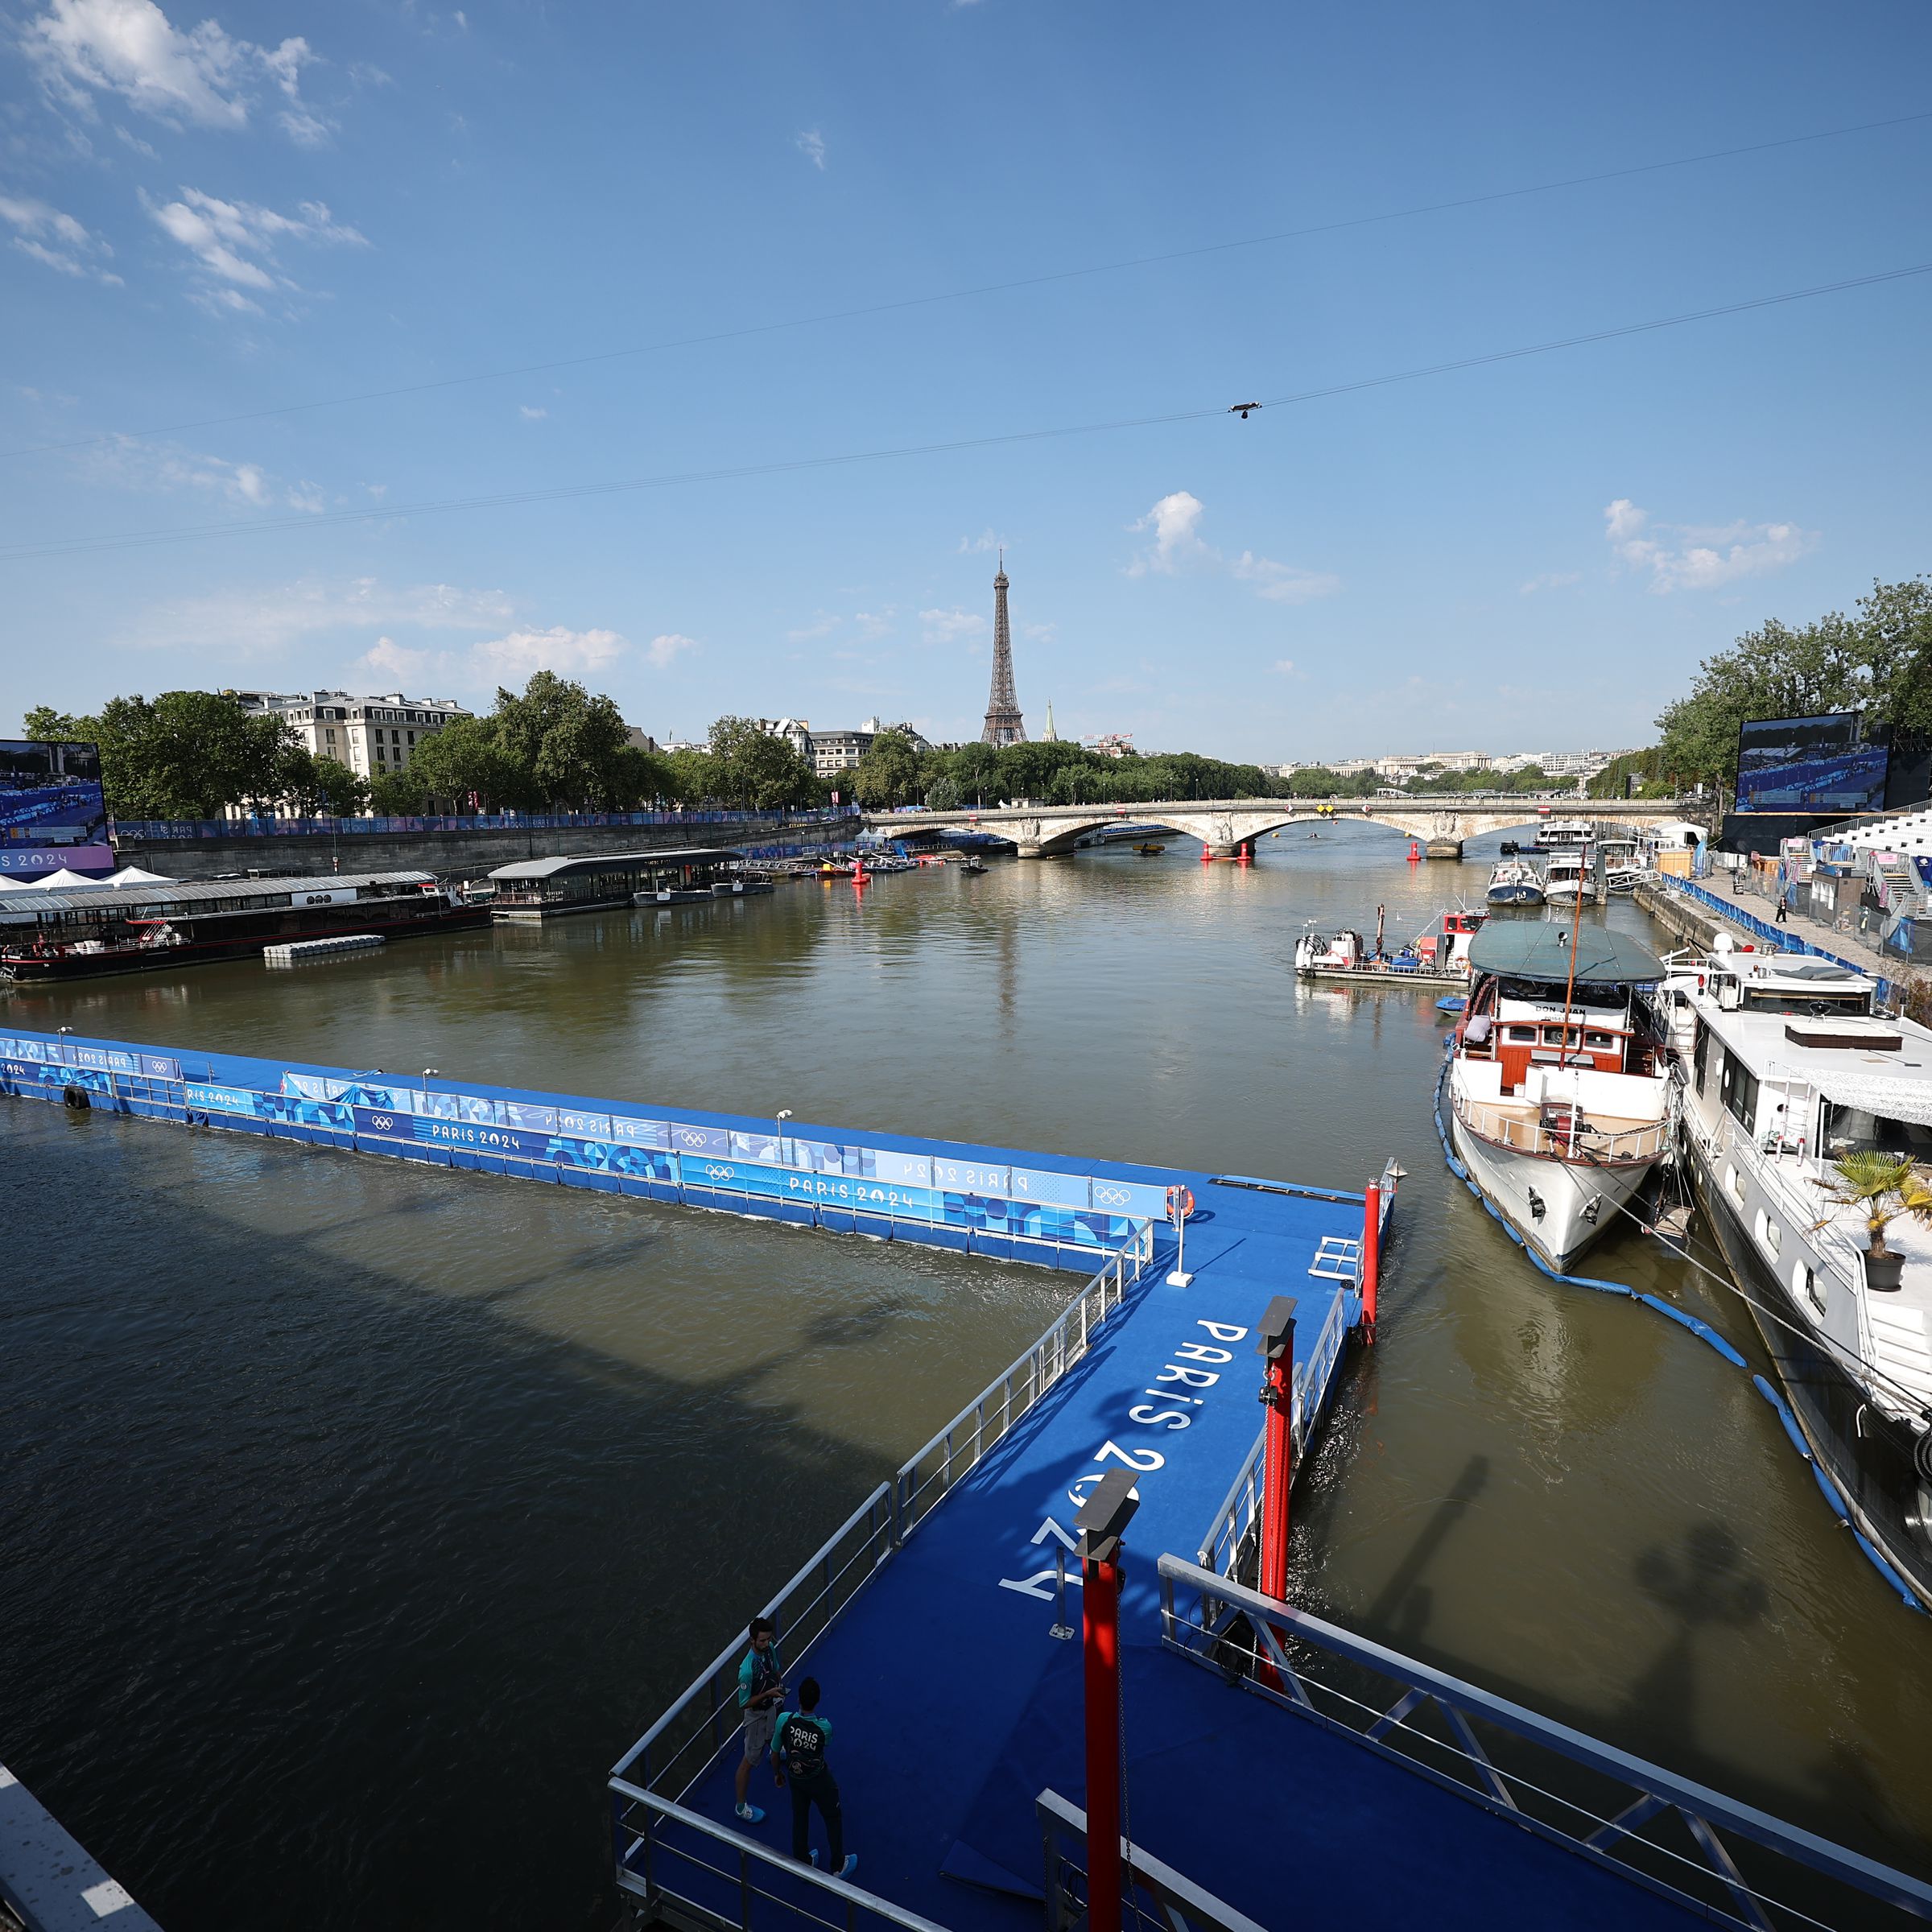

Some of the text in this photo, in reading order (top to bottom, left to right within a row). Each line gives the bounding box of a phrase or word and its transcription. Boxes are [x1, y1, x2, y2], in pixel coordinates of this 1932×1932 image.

[18, 853, 68, 866] 2024
[1, 1063, 26, 1075] 2024
[208, 1092, 239, 1106] 2024
[479, 1130, 520, 1150] 2024
[857, 1186, 913, 1208] 2024
[790, 1736, 816, 1752] 024
